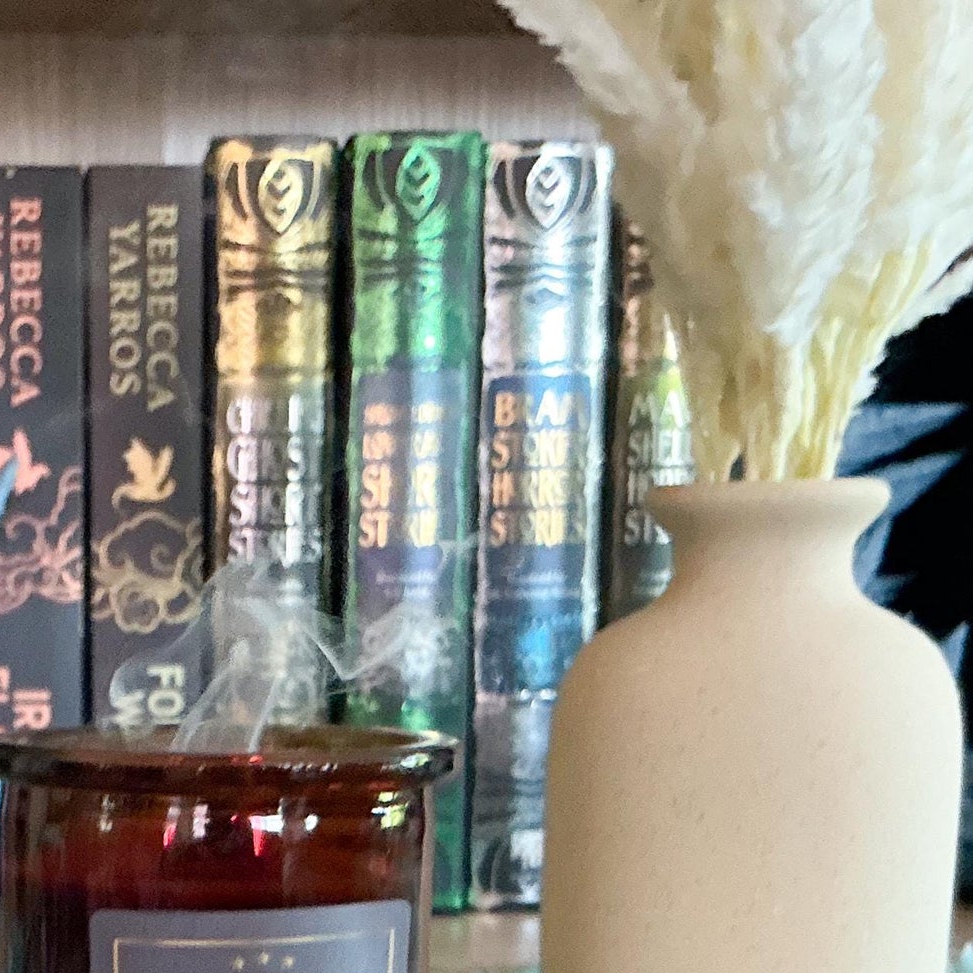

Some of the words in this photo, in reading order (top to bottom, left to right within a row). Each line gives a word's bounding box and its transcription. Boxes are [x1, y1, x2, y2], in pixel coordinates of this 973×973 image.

[9, 196, 43, 408] REBECCA
[109, 219, 142, 397] YARROS
[146, 203, 179, 412] REBECCA
